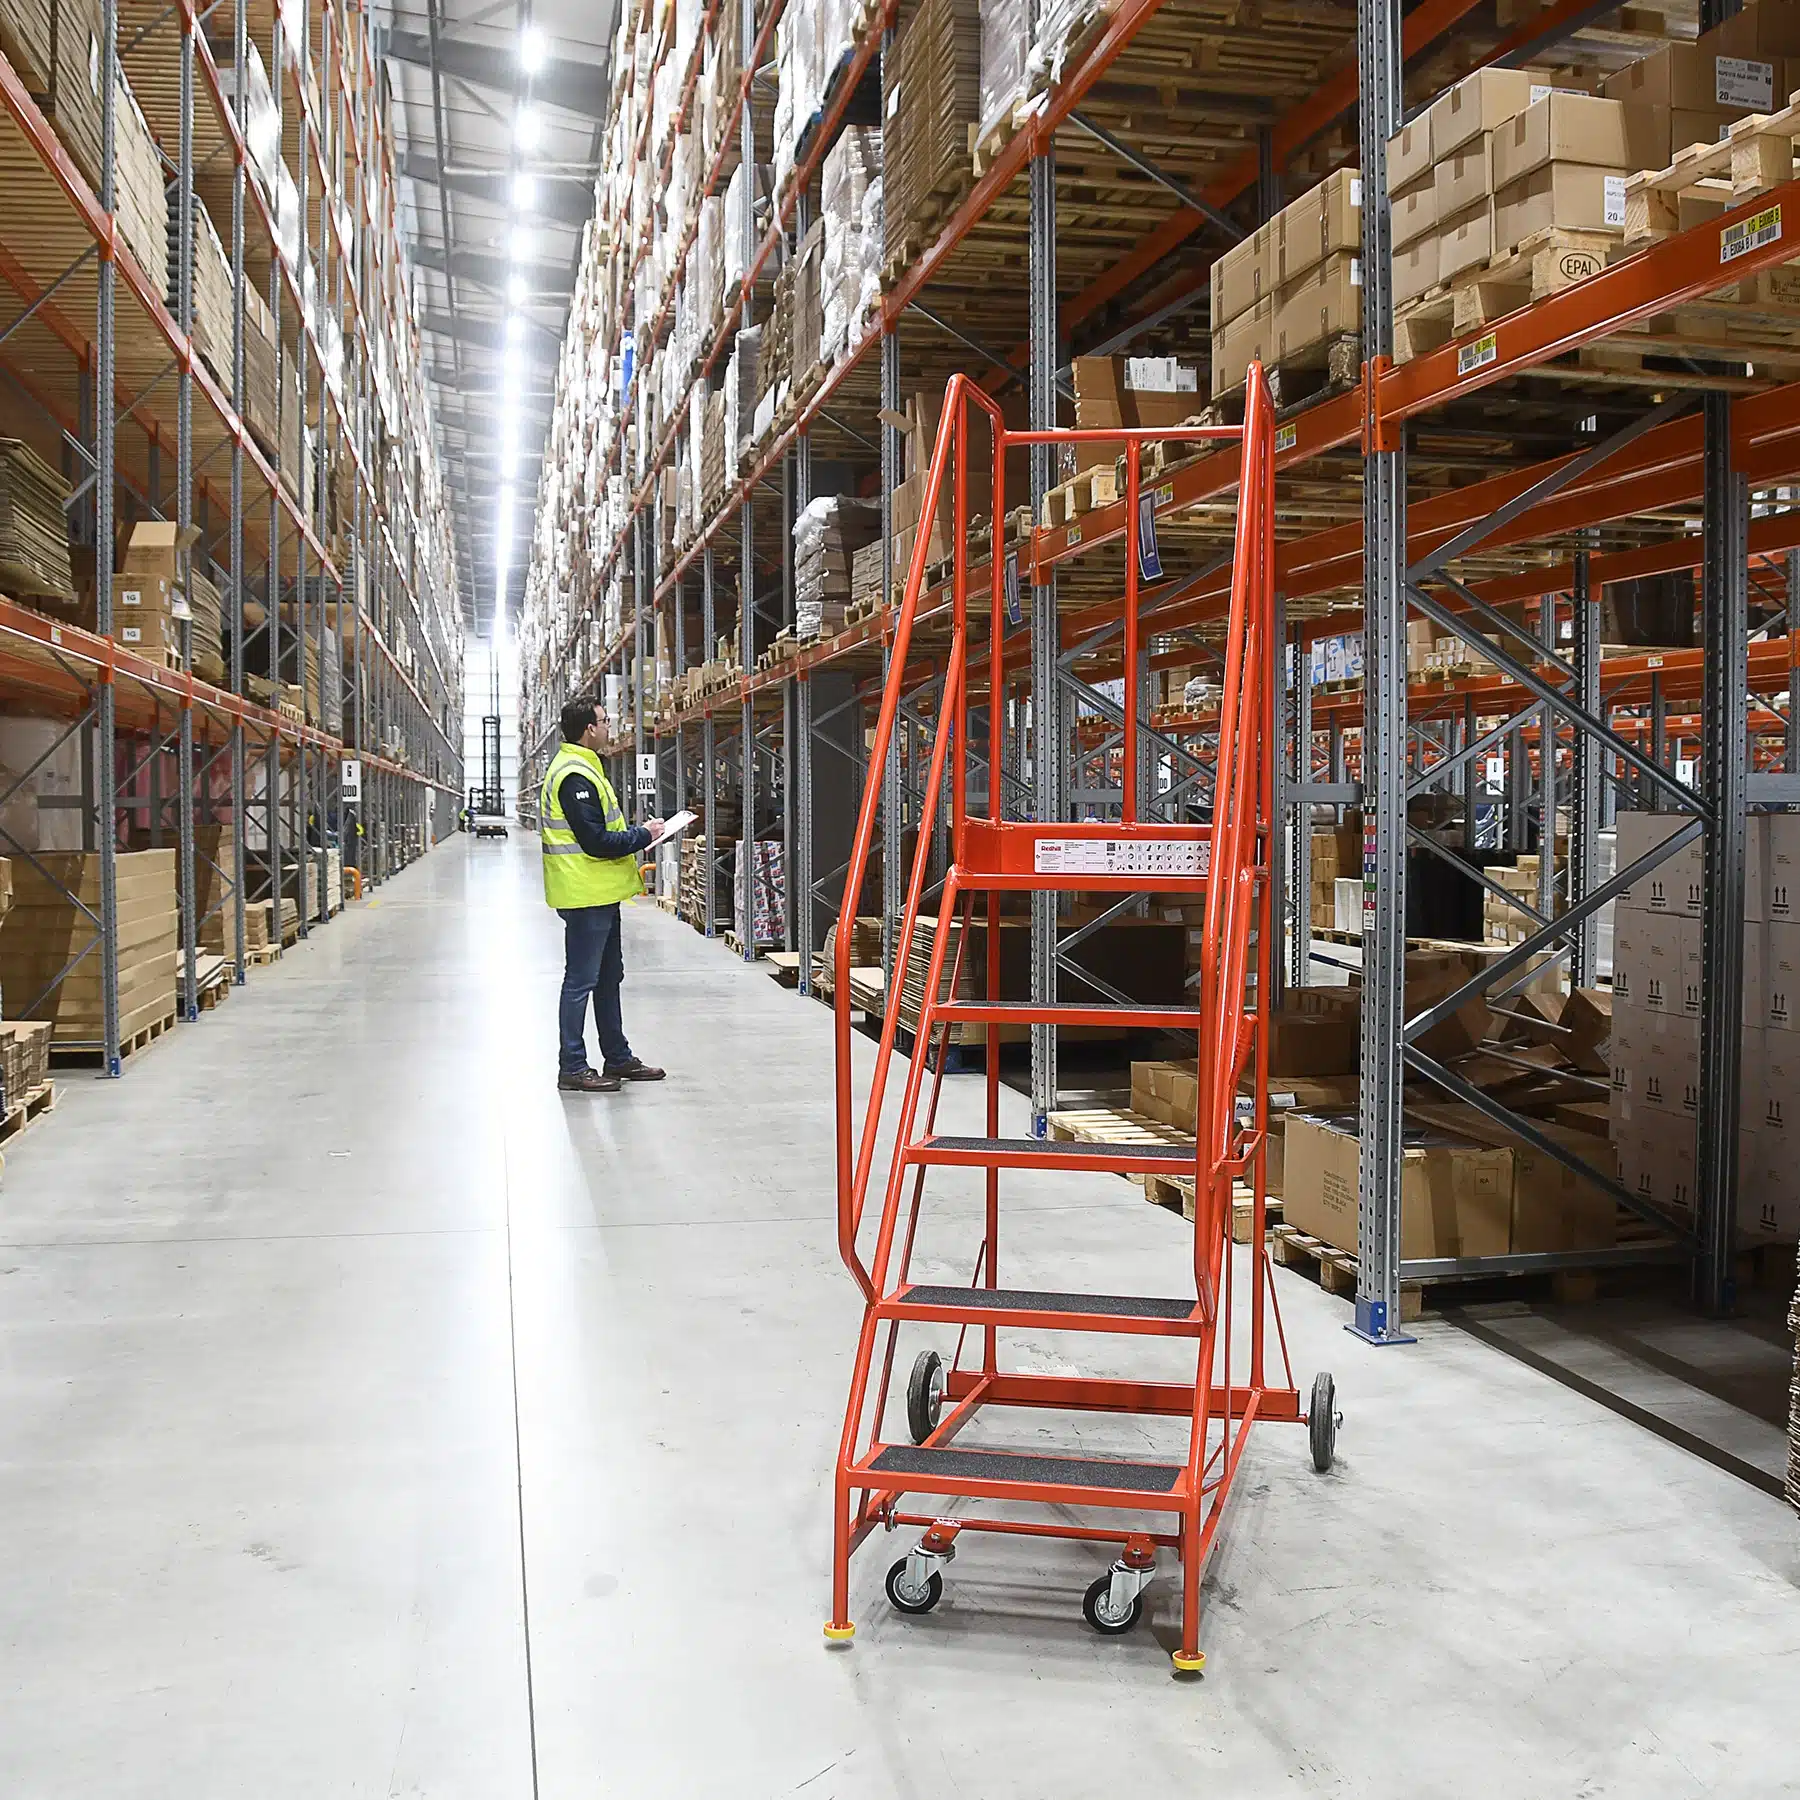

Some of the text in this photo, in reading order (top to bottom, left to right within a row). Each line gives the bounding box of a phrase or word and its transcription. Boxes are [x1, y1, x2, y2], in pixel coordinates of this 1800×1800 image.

[1719, 91, 1729, 101] 20
[1607, 211, 1618, 221] 20
[1566, 259, 1592, 275] EPAL
[638, 778, 656, 789] EVEN
